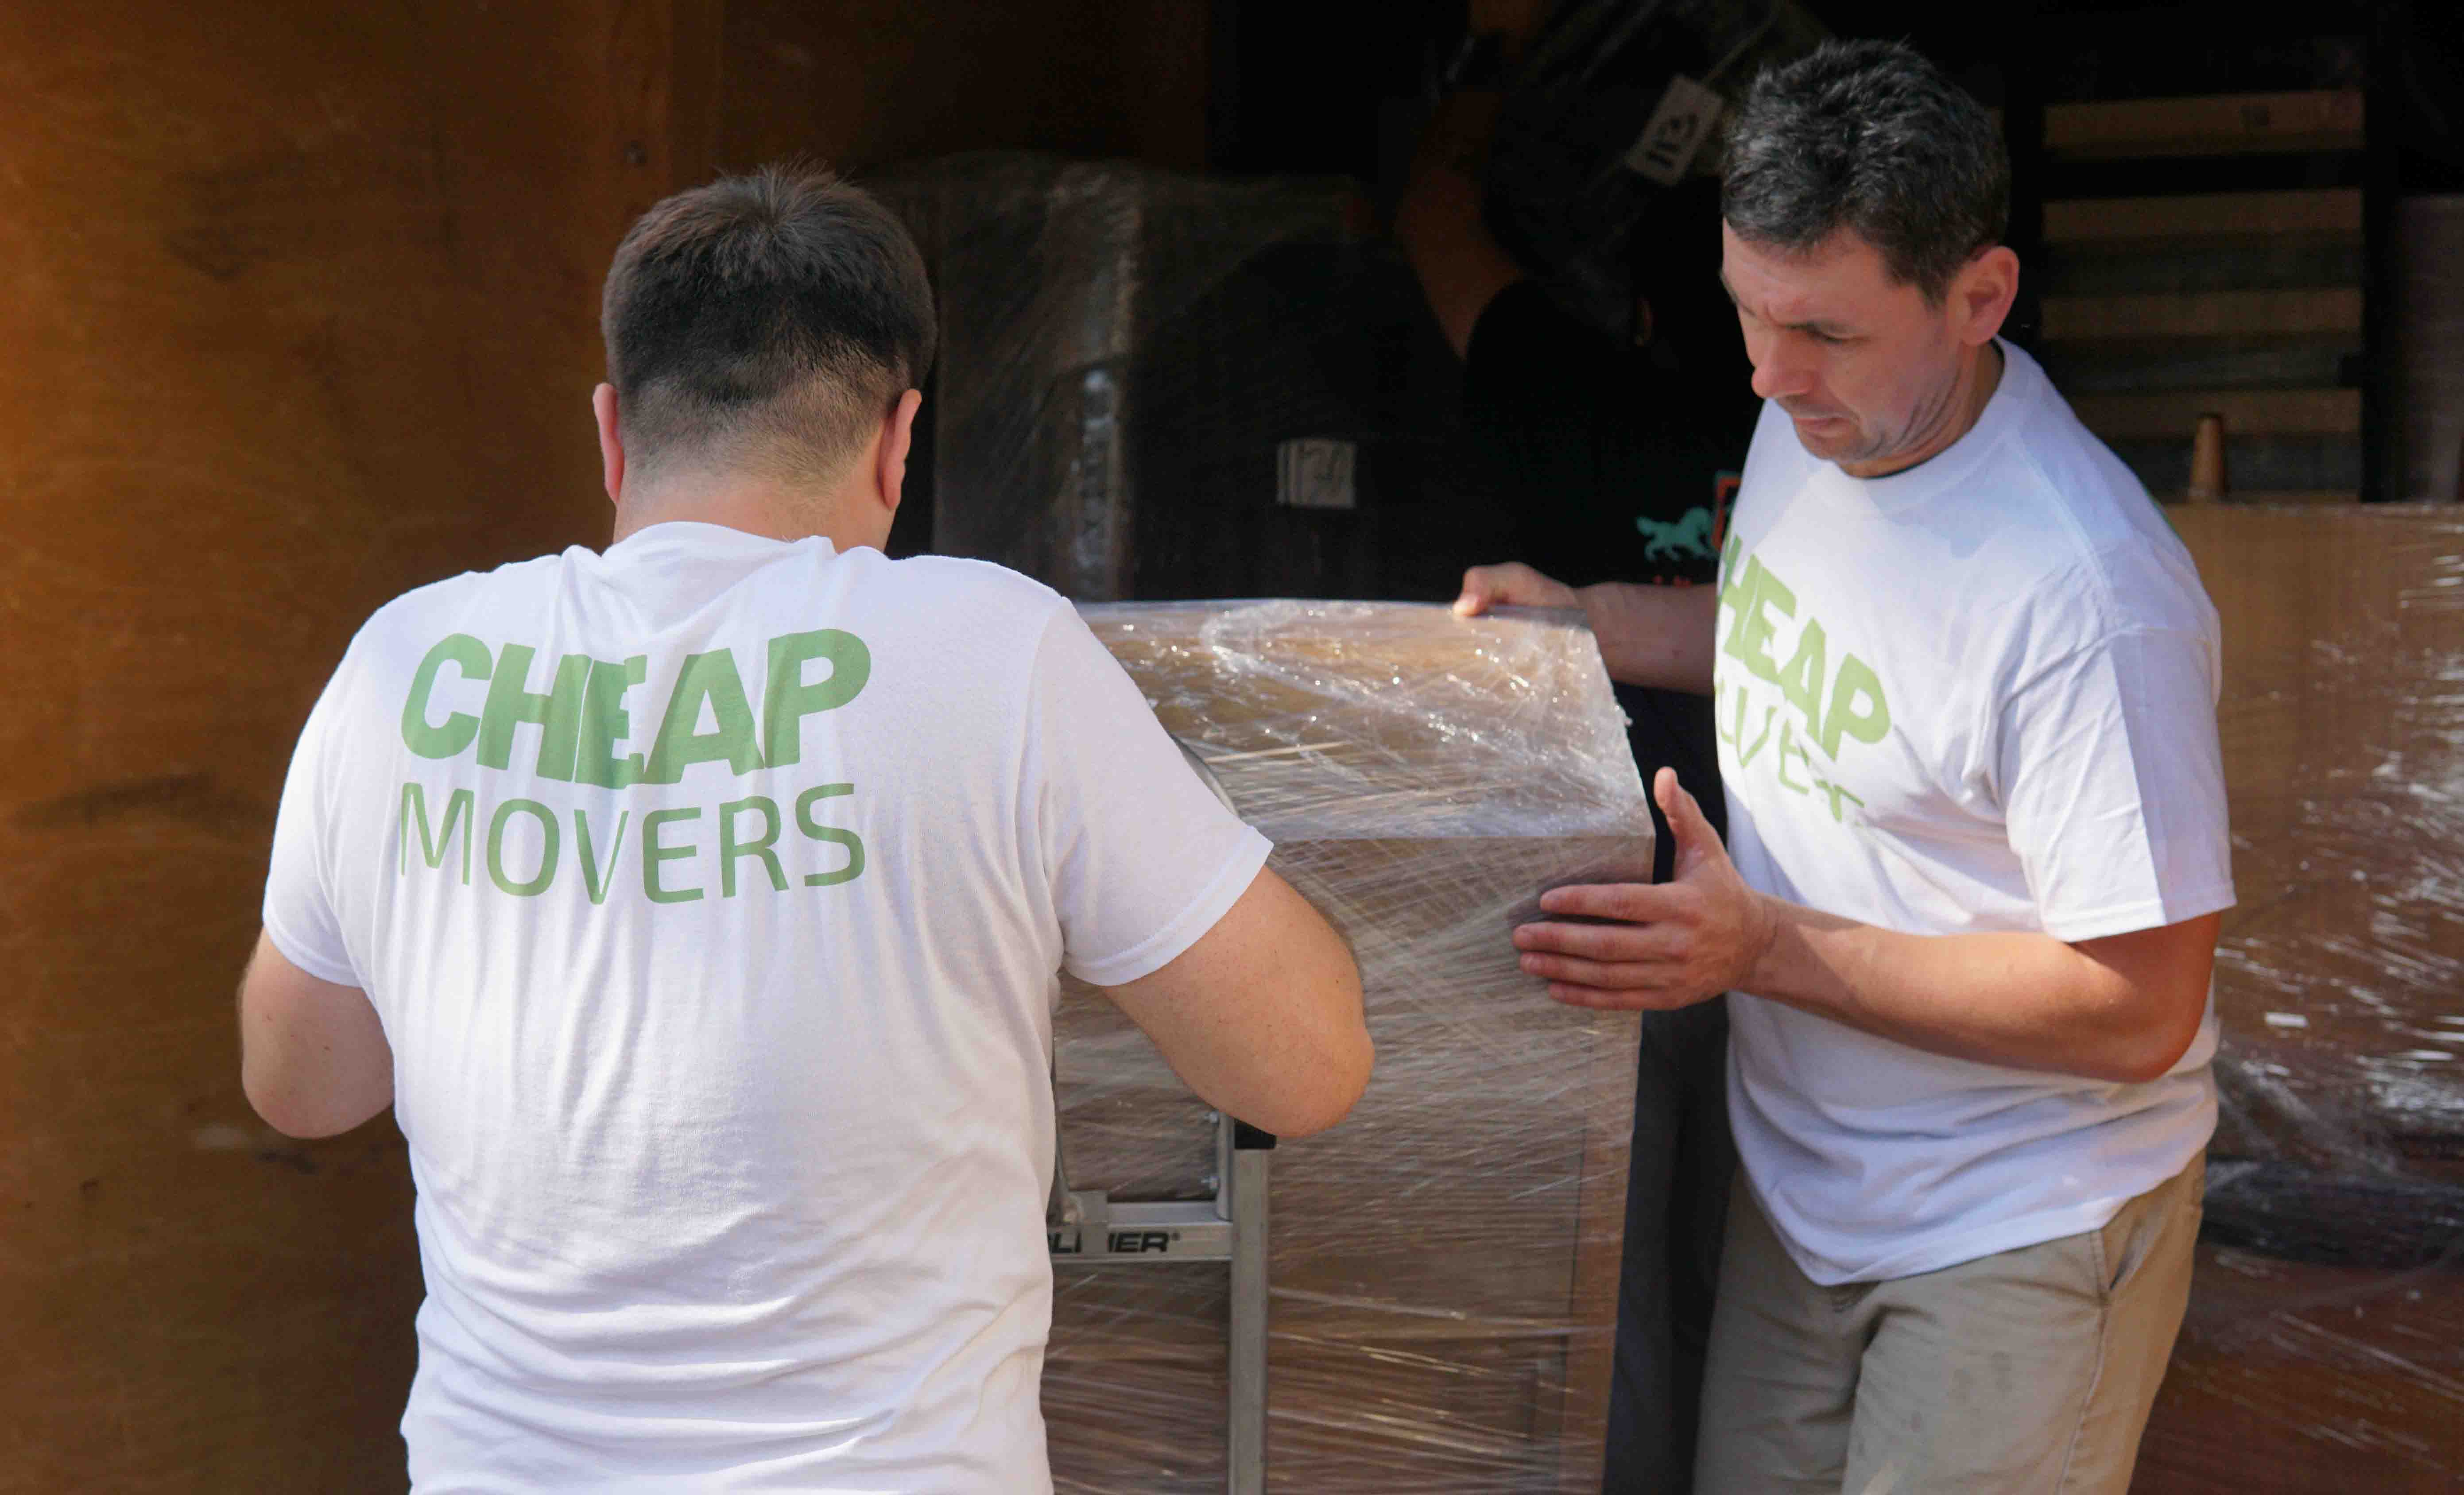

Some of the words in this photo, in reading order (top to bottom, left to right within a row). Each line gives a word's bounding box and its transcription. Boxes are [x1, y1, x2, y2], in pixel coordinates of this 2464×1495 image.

[401, 628, 871, 789] CHEAP
[1716, 529, 1891, 762] HEAP
[401, 782, 866, 905] MOVERS
